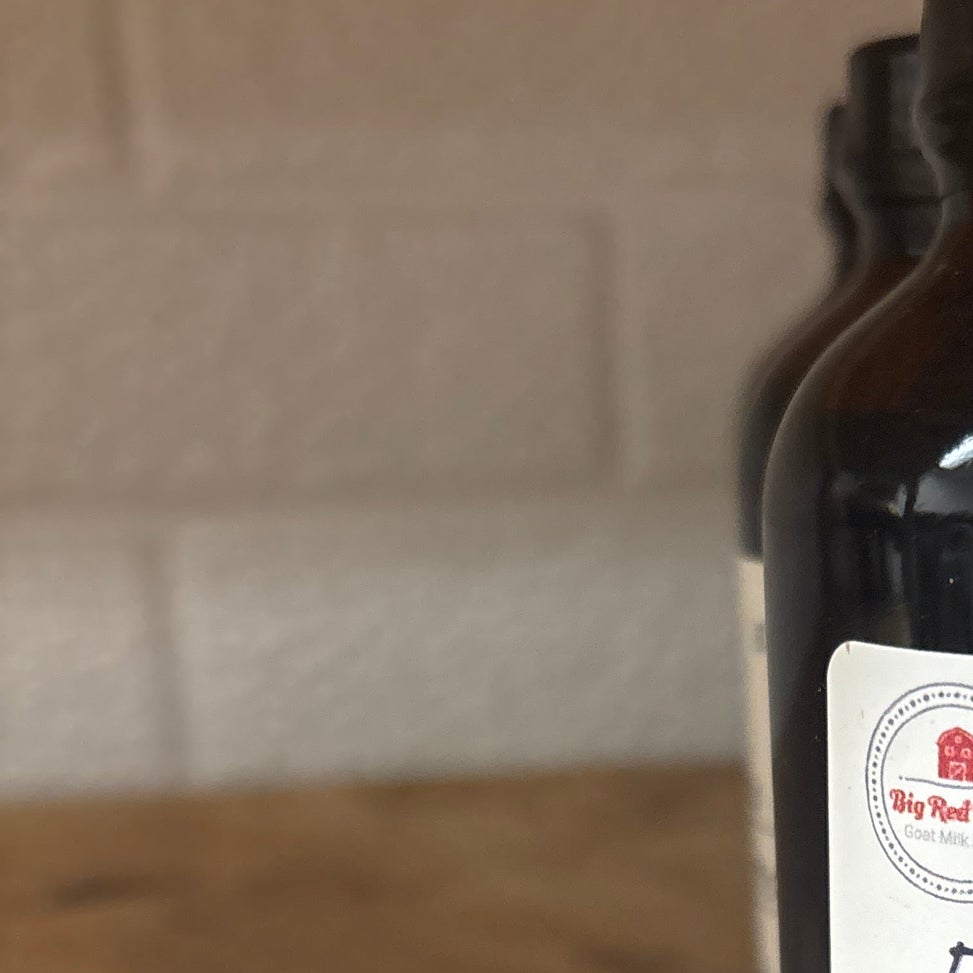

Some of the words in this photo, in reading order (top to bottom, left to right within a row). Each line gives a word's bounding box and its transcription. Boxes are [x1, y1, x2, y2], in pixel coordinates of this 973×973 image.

[889, 788, 925, 820] Big
[927, 795, 971, 823] Red
[904, 824, 936, 843] Goat
[938, 829, 970, 848] Milk
